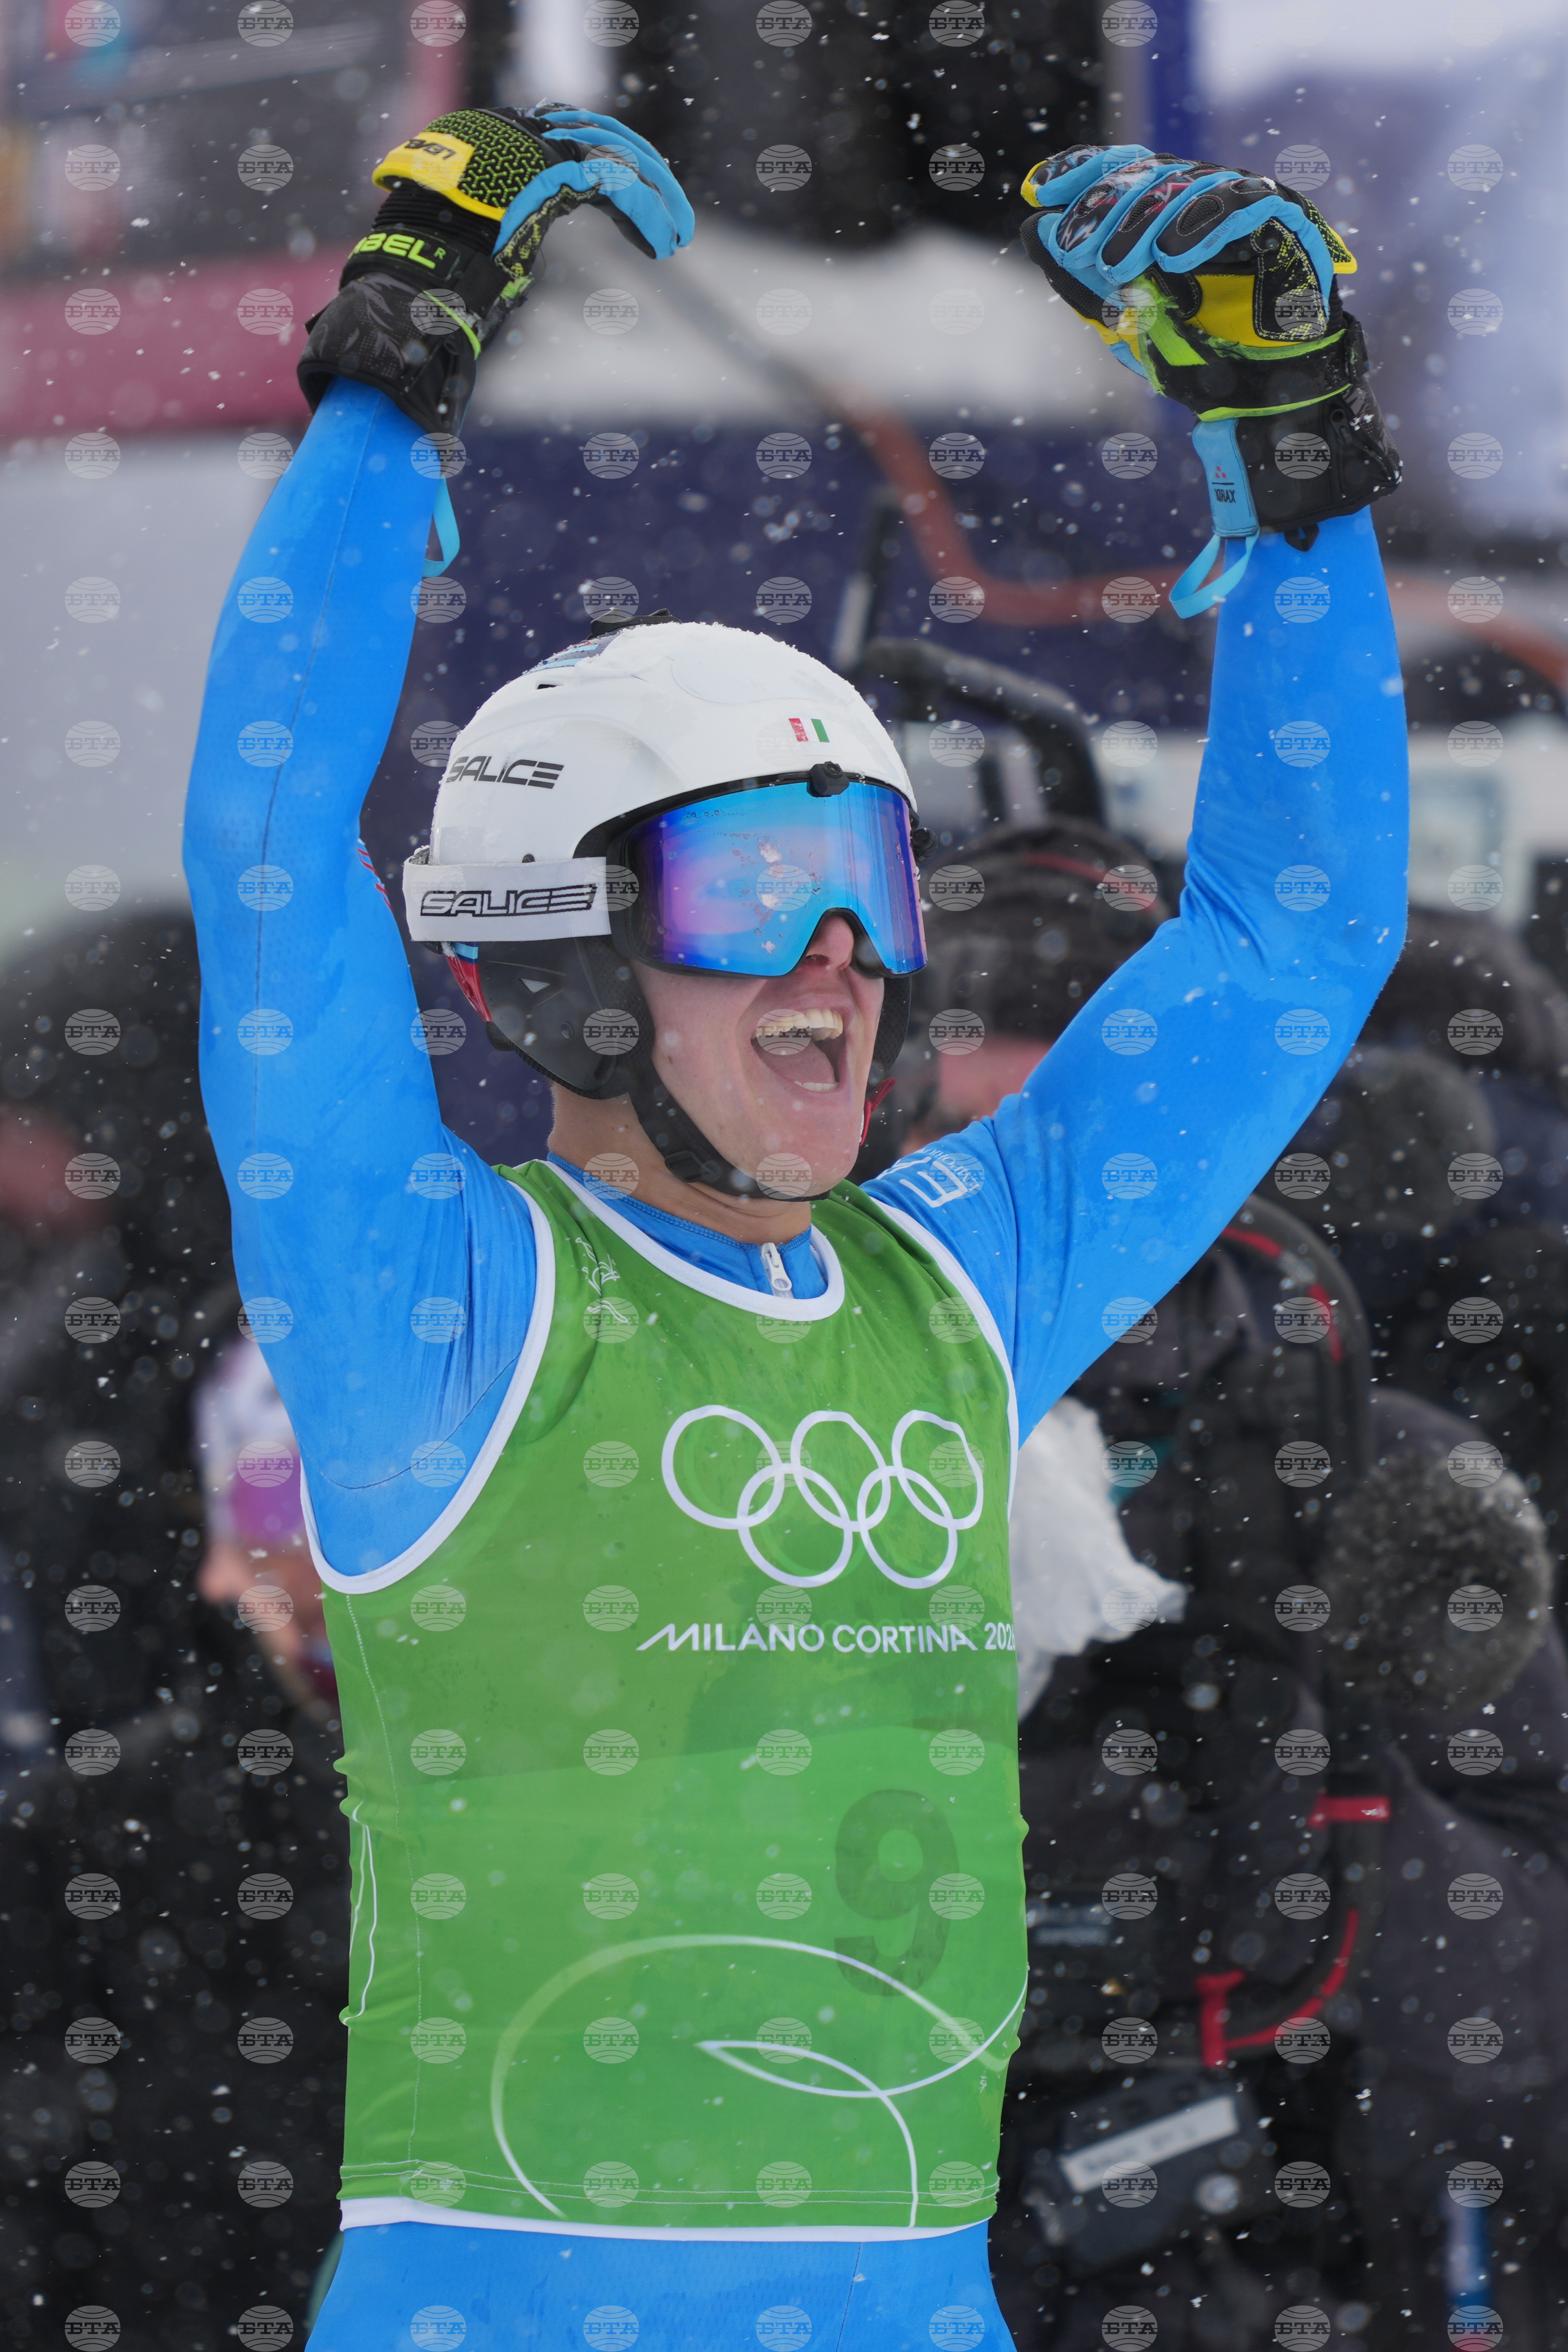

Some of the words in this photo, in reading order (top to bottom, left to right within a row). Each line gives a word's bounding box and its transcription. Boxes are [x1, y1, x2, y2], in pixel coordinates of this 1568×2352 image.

[446, 756, 565, 789] SALICE
[420, 883, 597, 917] SALICE
[636, 1623, 825, 1652] MILANO
[832, 1624, 978, 1653] CORTINA
[834, 1789, 960, 1996] 9
